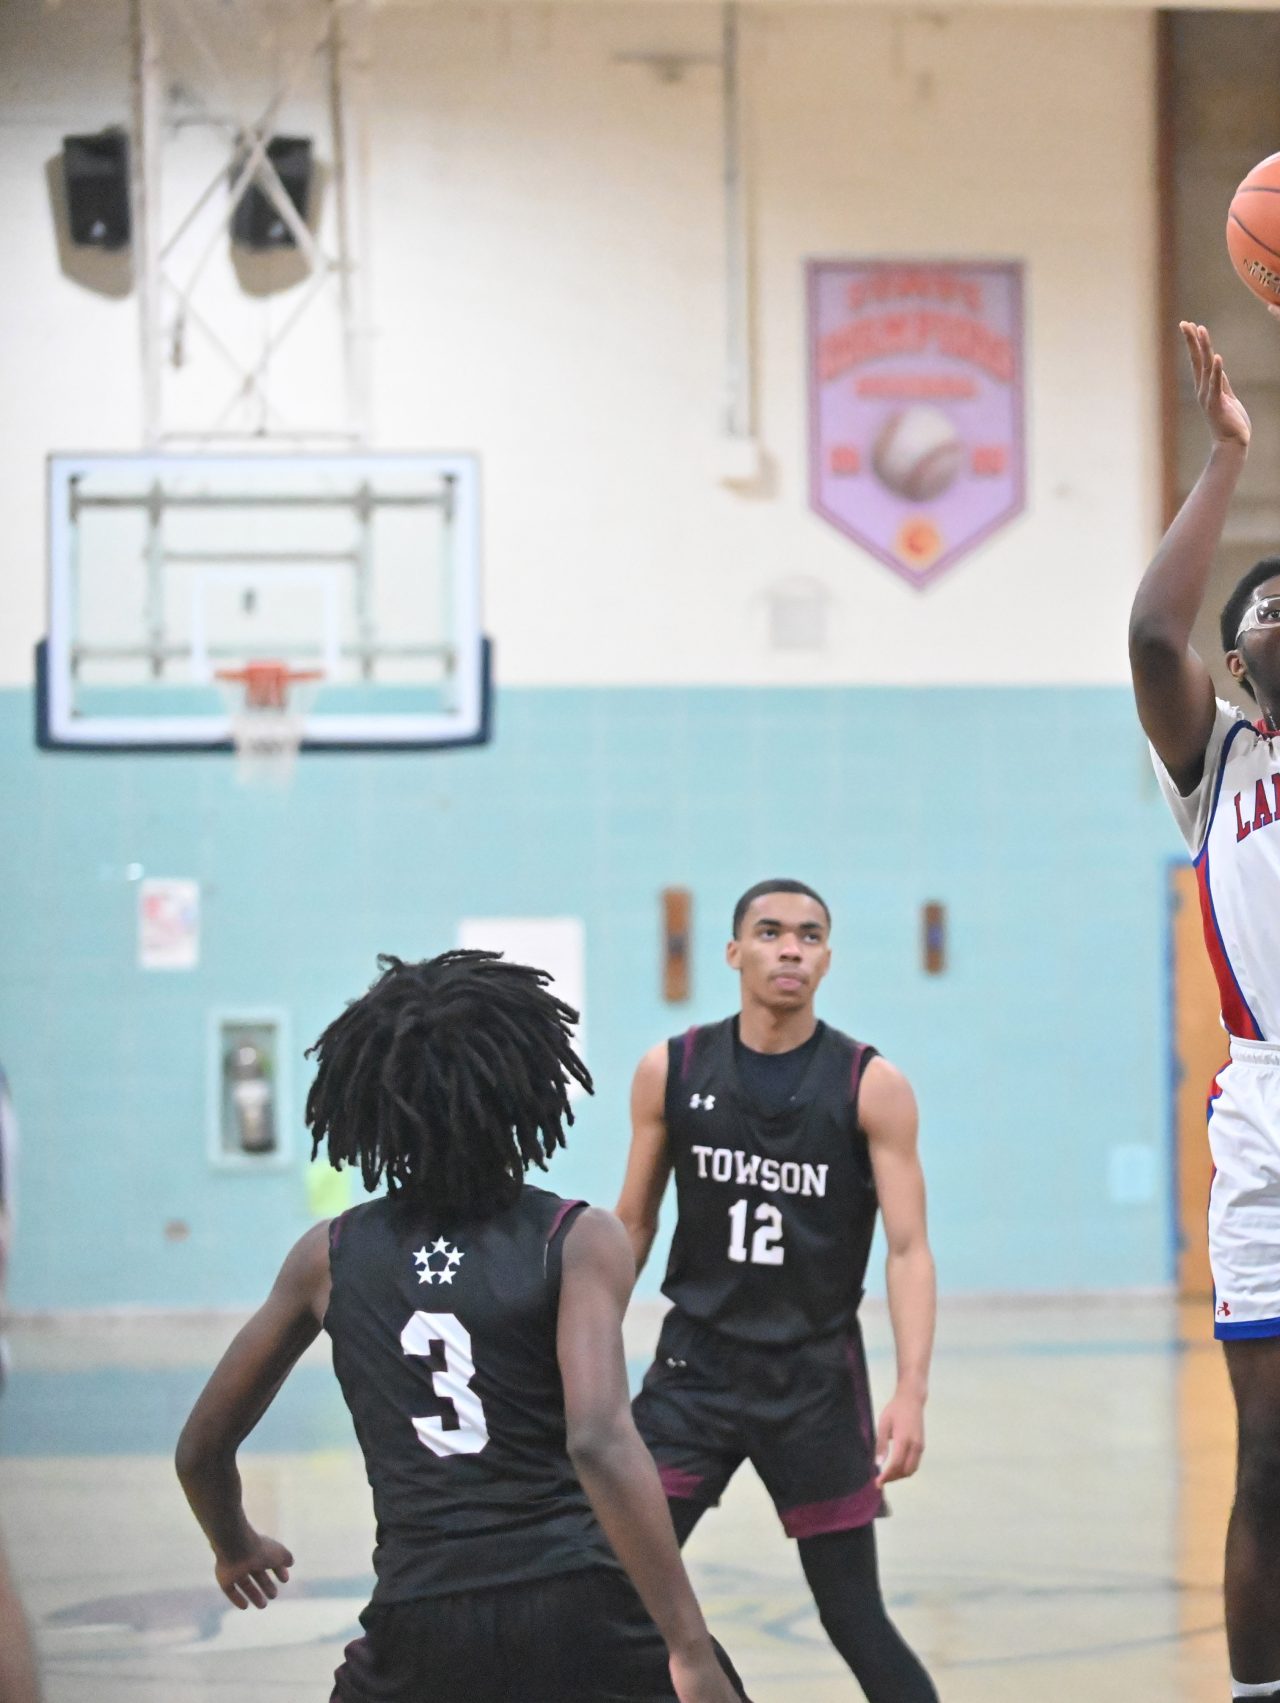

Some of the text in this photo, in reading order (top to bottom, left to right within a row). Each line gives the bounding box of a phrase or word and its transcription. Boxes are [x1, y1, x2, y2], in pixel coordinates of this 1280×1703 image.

[691, 1144, 829, 1197] TOWSON
[728, 1199, 785, 1265] 12
[400, 1310, 491, 1458] 3
